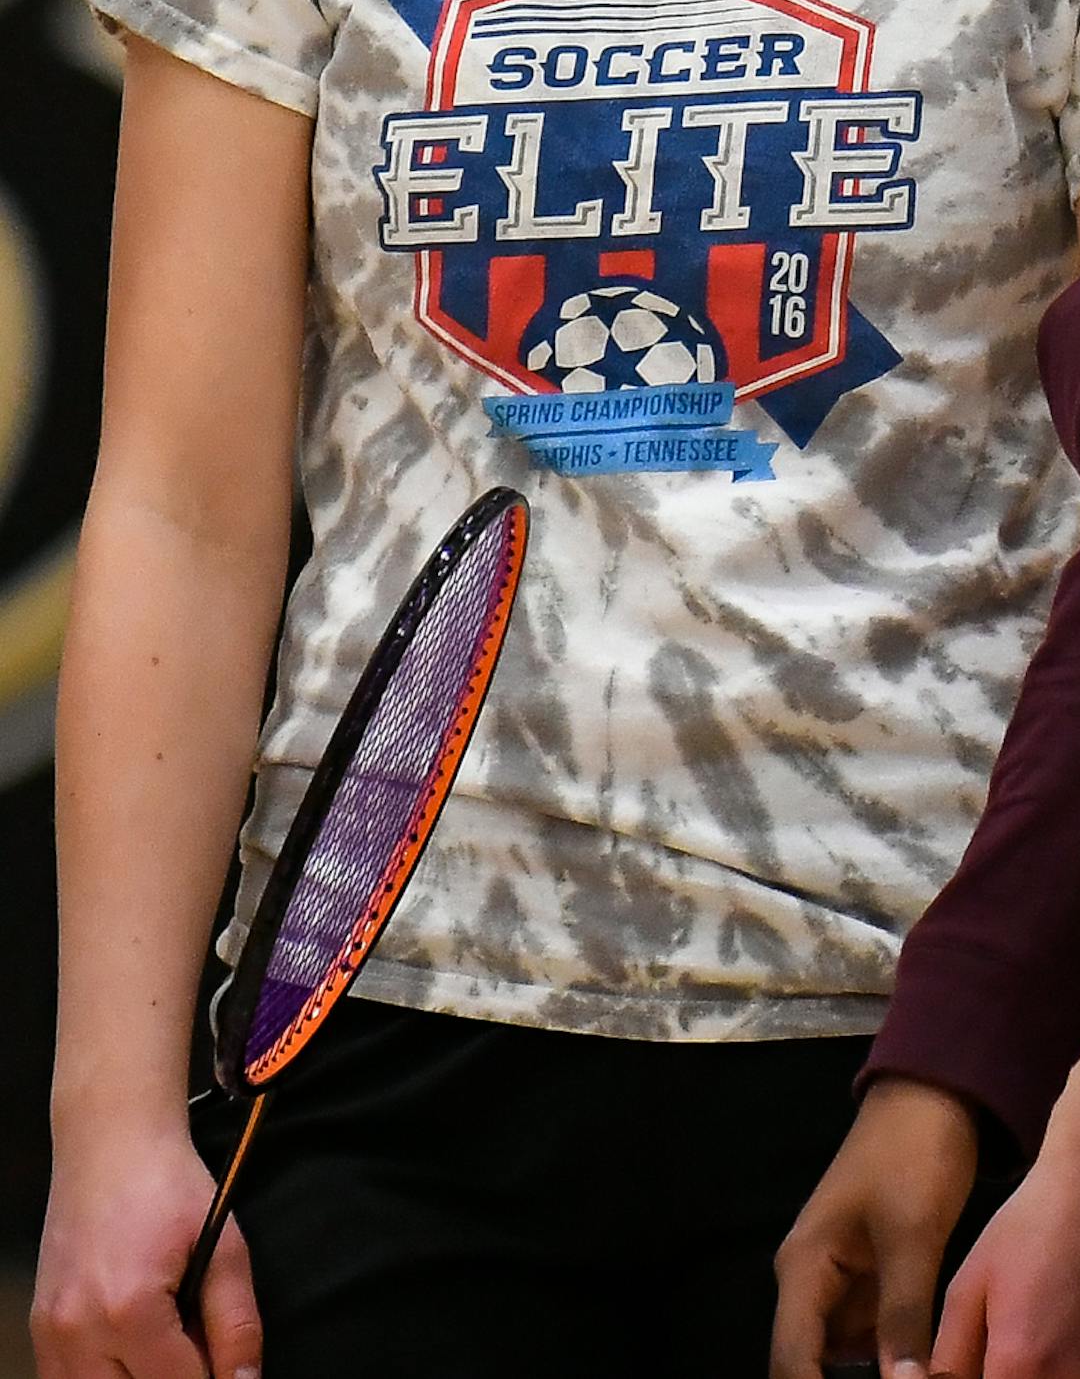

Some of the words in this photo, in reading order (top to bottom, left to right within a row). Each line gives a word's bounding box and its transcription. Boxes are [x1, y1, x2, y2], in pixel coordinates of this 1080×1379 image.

[487, 33, 806, 90] SOCCER
[380, 96, 917, 246] ELITE
[769, 251, 809, 294] 20
[768, 293, 806, 338] 16
[494, 402, 564, 428] SPRING
[570, 391, 723, 423] CHAMPIONSHIP
[623, 438, 739, 464] TENNESSEE
